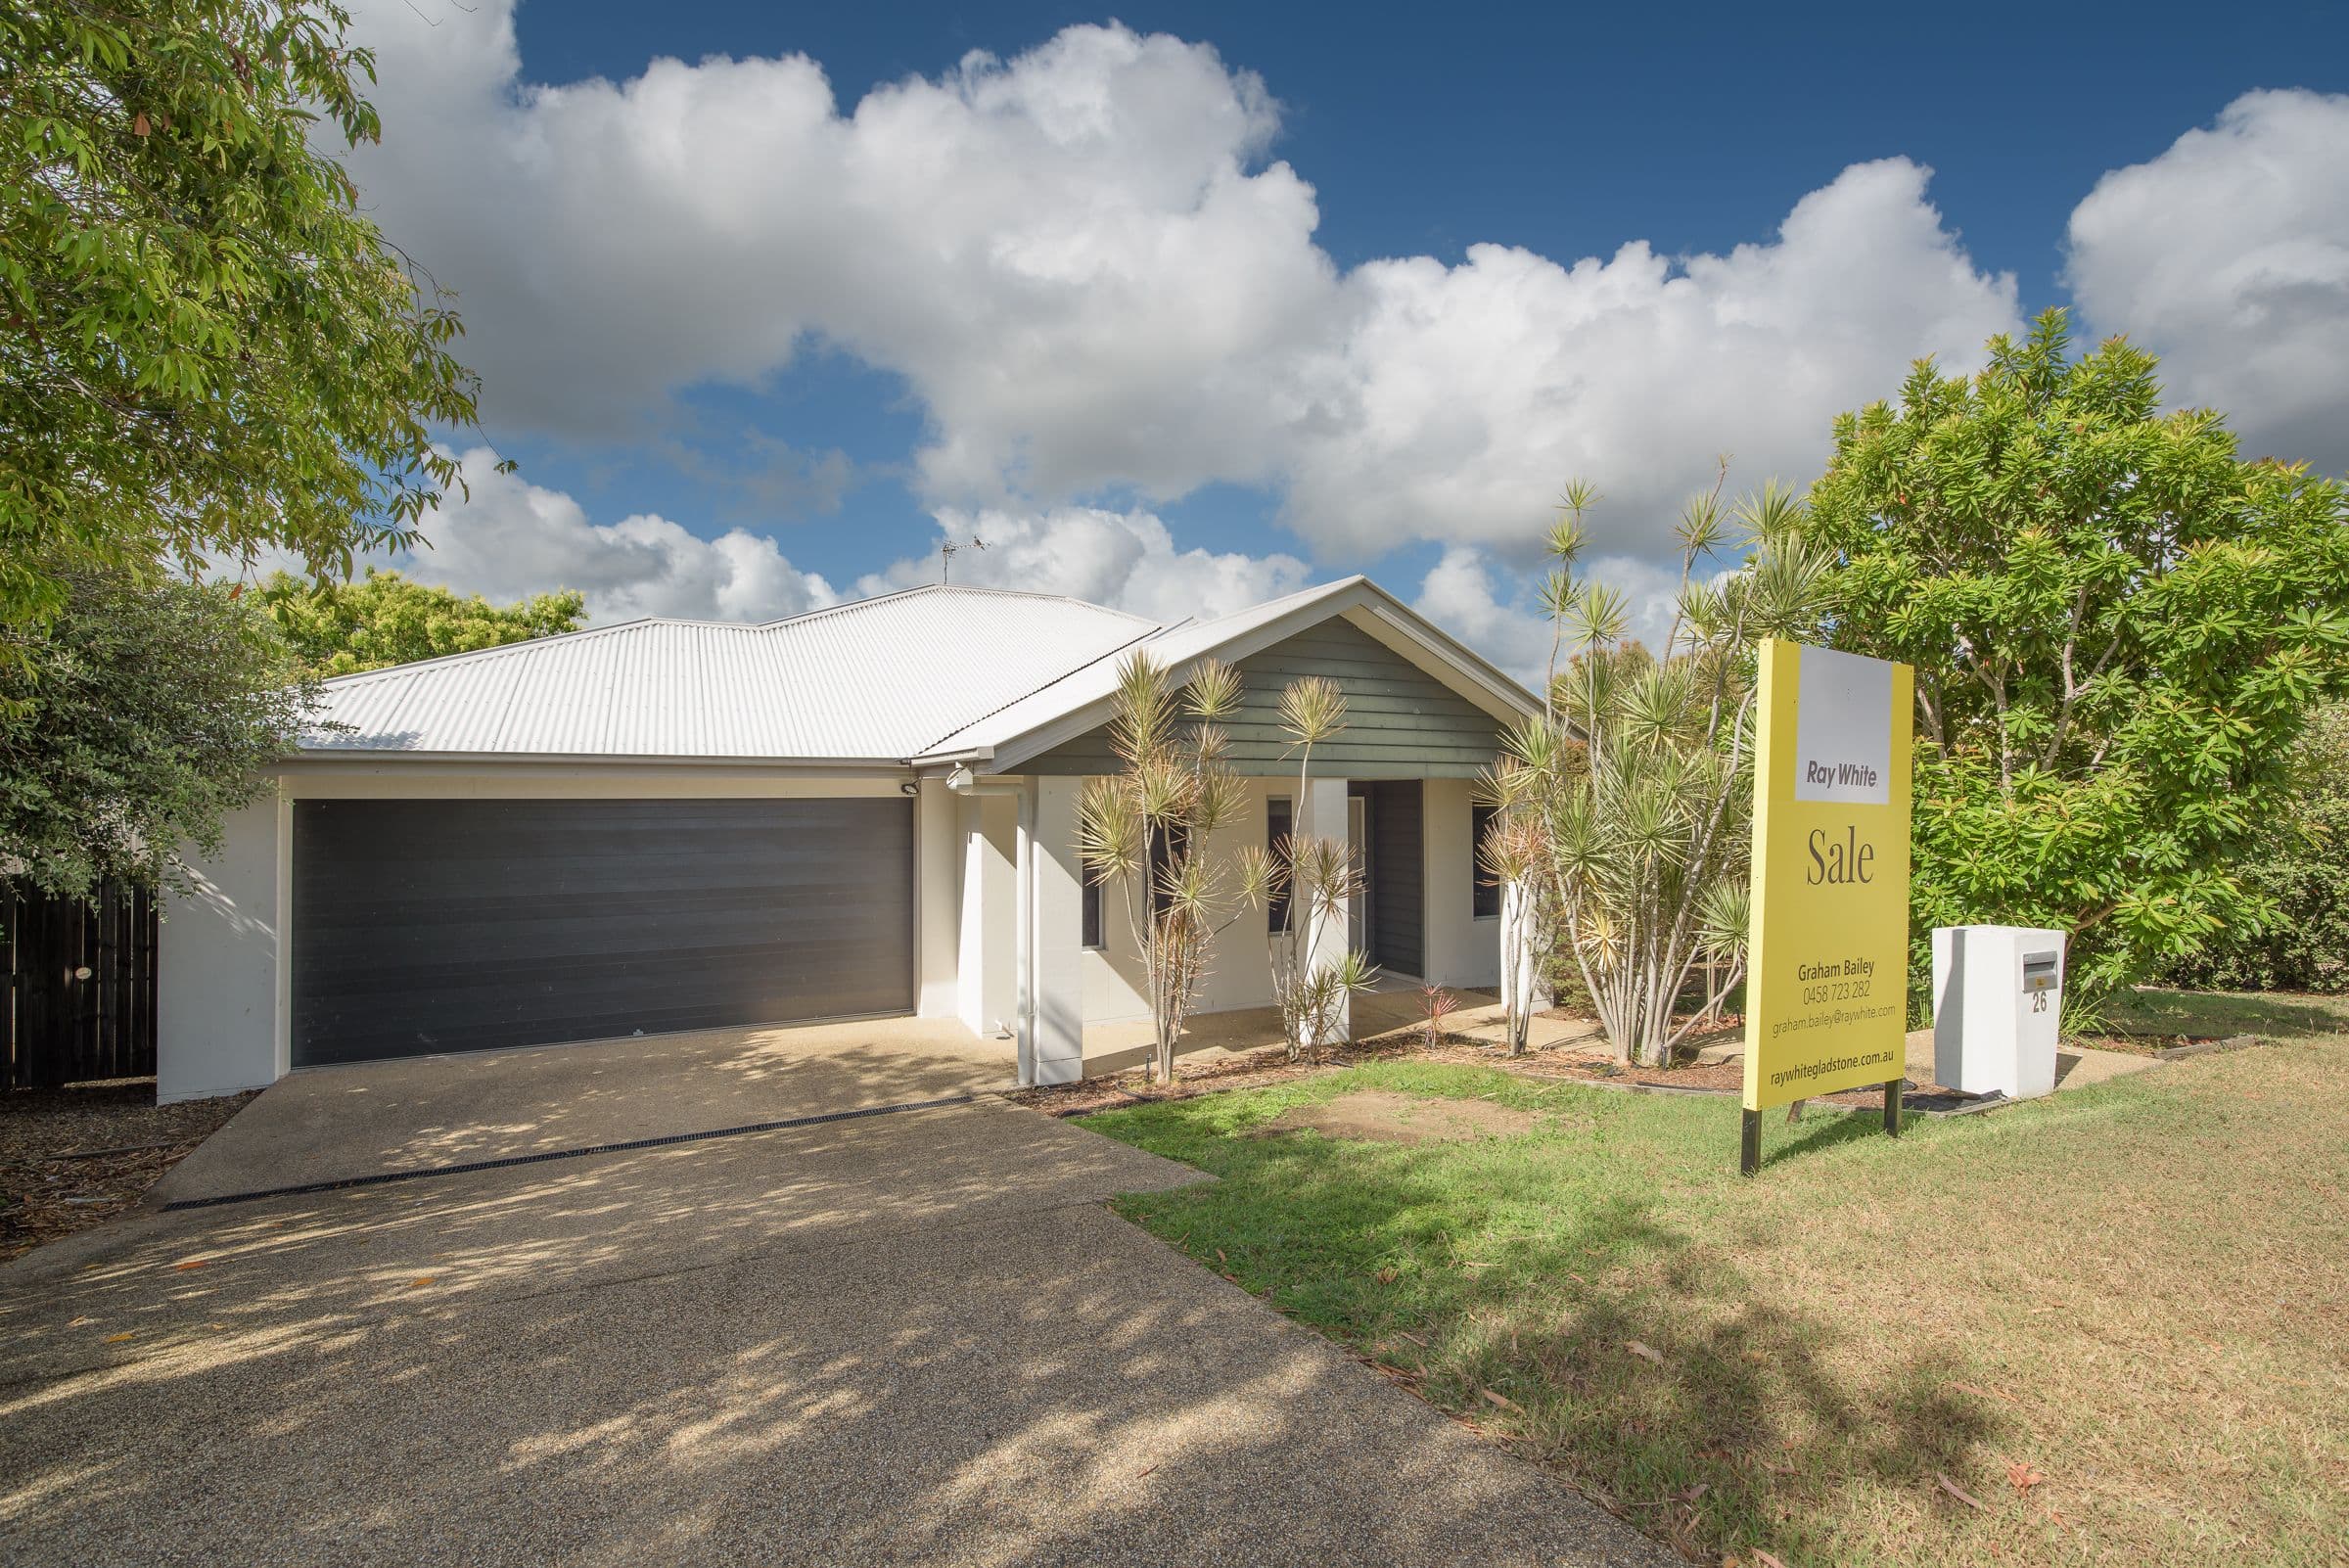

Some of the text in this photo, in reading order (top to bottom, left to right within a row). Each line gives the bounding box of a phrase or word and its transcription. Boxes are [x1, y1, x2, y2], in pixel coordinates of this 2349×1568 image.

[1807, 760, 1877, 789] Ray White
[1807, 825, 1874, 886] Sale
[1798, 957, 1874, 982] Graham Bailey
[1803, 980, 1870, 1005] 0458 723 282
[2033, 991, 2047, 1013] 26
[1773, 1004, 1896, 1038] graham.bailey@raywhite.com
[1771, 1050, 1894, 1086] raywhitegladstone.com.au
